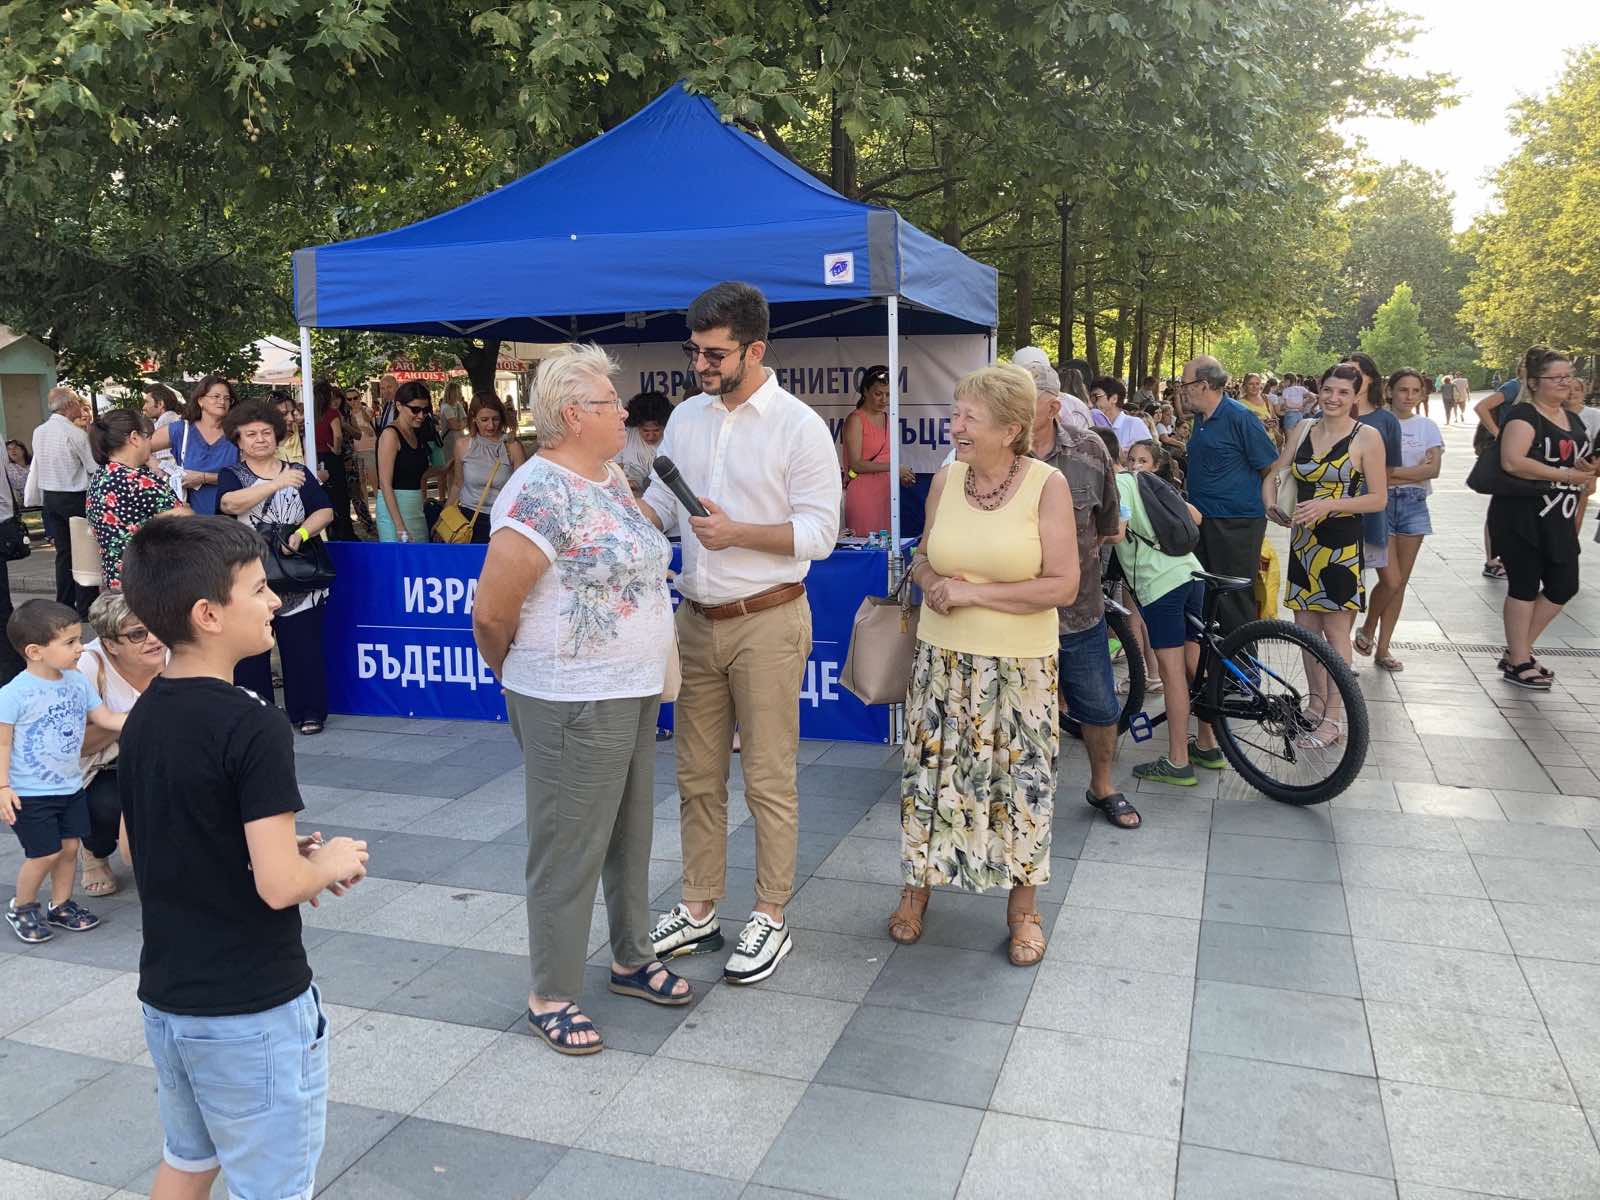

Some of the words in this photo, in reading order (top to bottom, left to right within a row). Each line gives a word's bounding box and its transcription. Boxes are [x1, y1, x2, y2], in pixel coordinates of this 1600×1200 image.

[640, 370, 699, 397] ИЗРА
[777, 366, 865, 394] ЕНИЕТО
[899, 417, 951, 450] ЪЦЕ
[403, 576, 479, 615] ИЗРА
[356, 642, 495, 691] БЪДЕЩЕ
